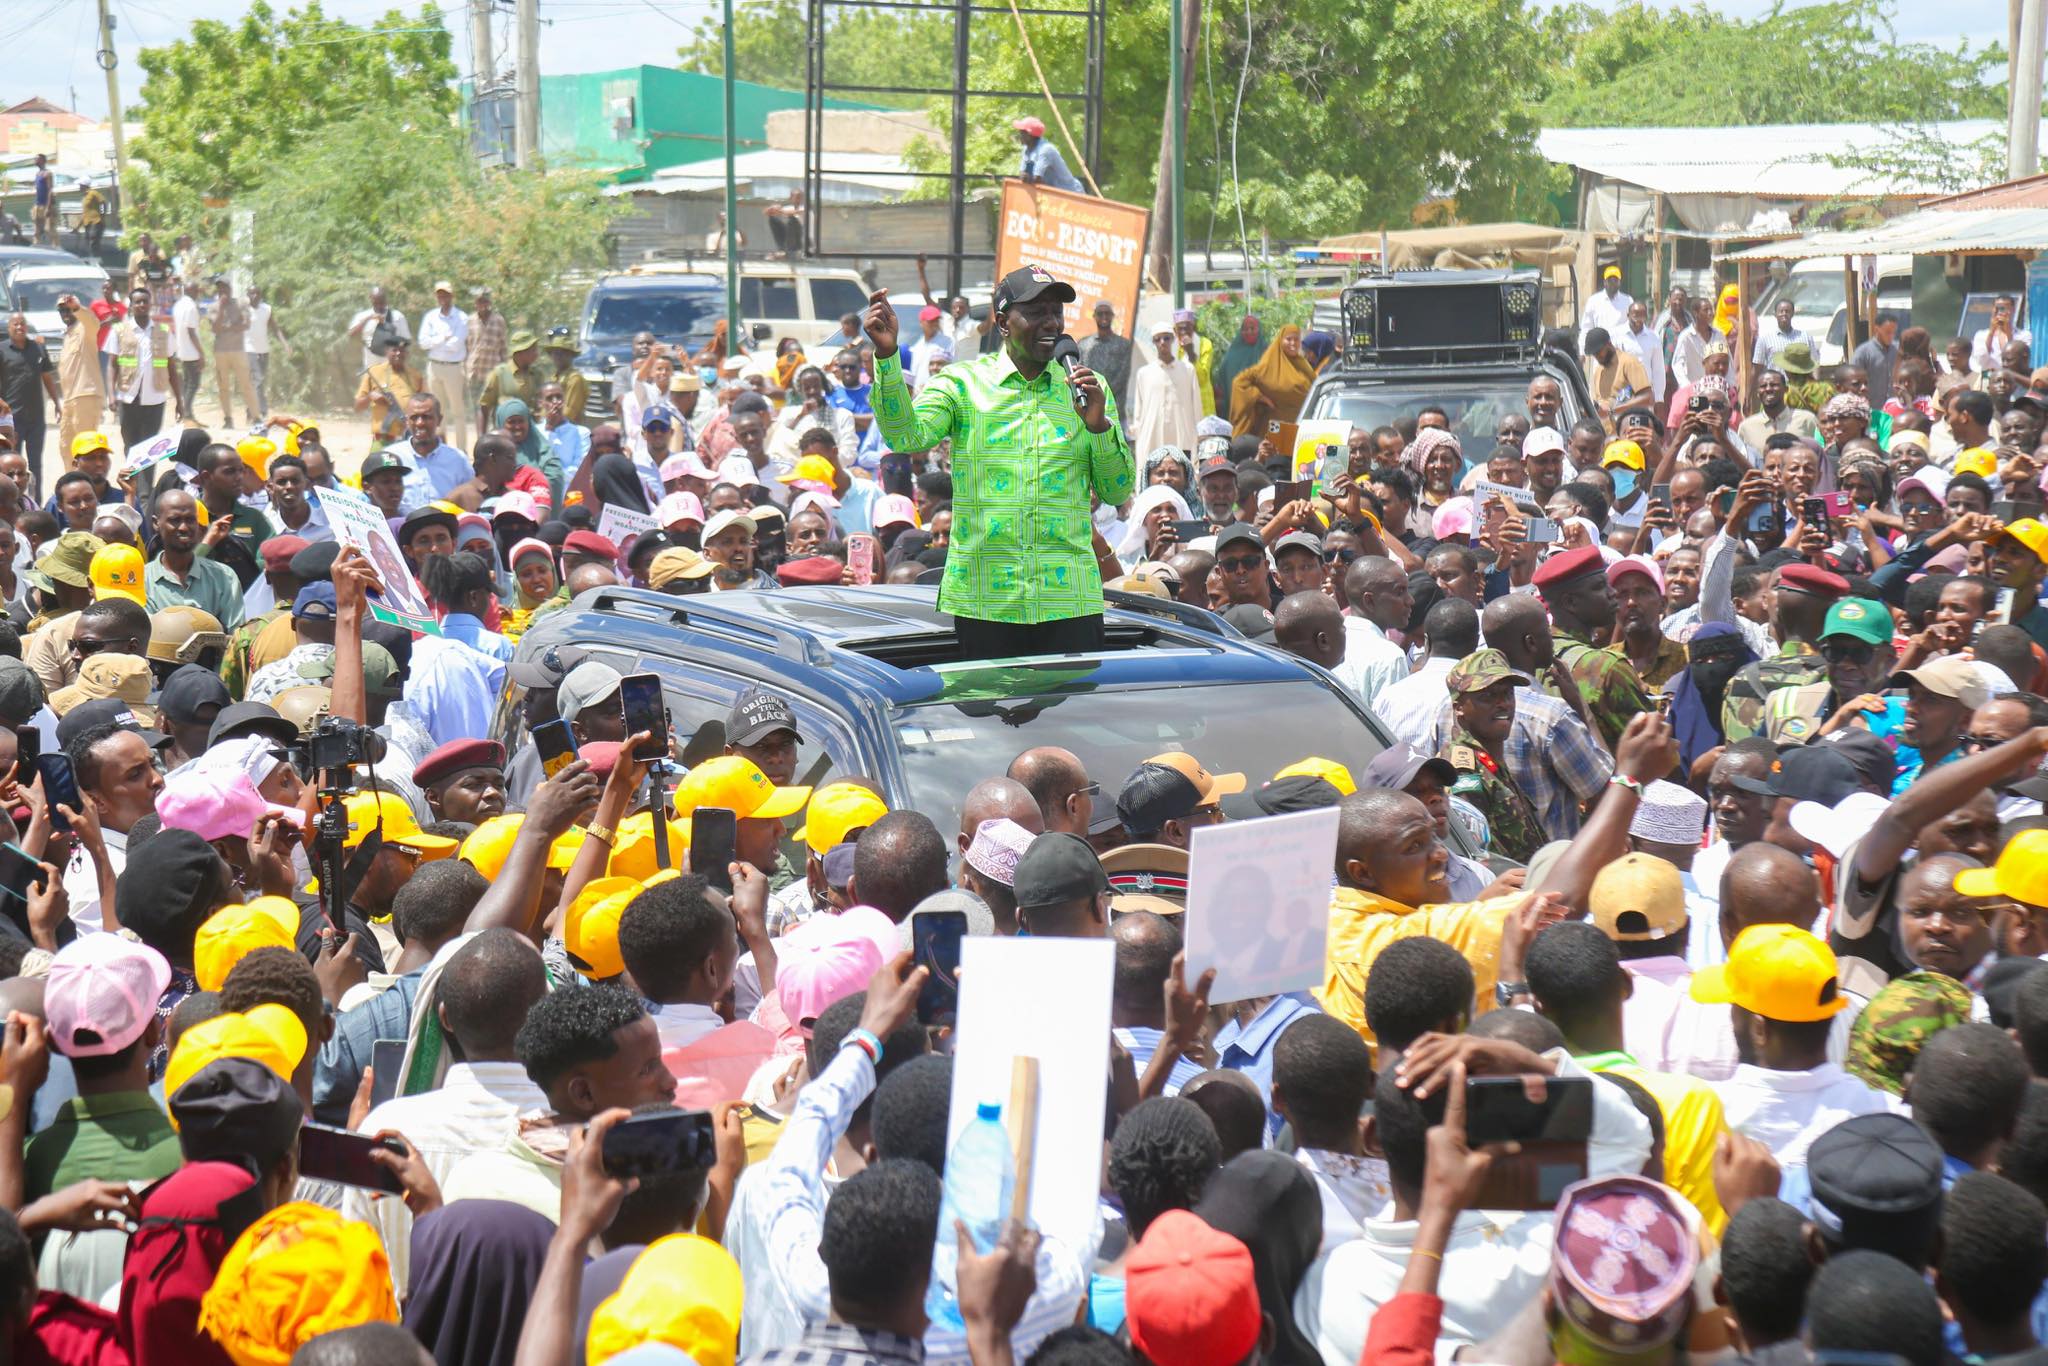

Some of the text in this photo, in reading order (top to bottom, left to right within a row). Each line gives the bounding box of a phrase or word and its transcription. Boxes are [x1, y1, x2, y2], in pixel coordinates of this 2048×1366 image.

[1056, 222, 1137, 265] RESORT
[320, 492, 362, 510] PRESIDENT
[1514, 492, 1533, 501] RUTO
[605, 508, 659, 527] PRESIDENT RUTO
[749, 710, 789, 726] BLACK
